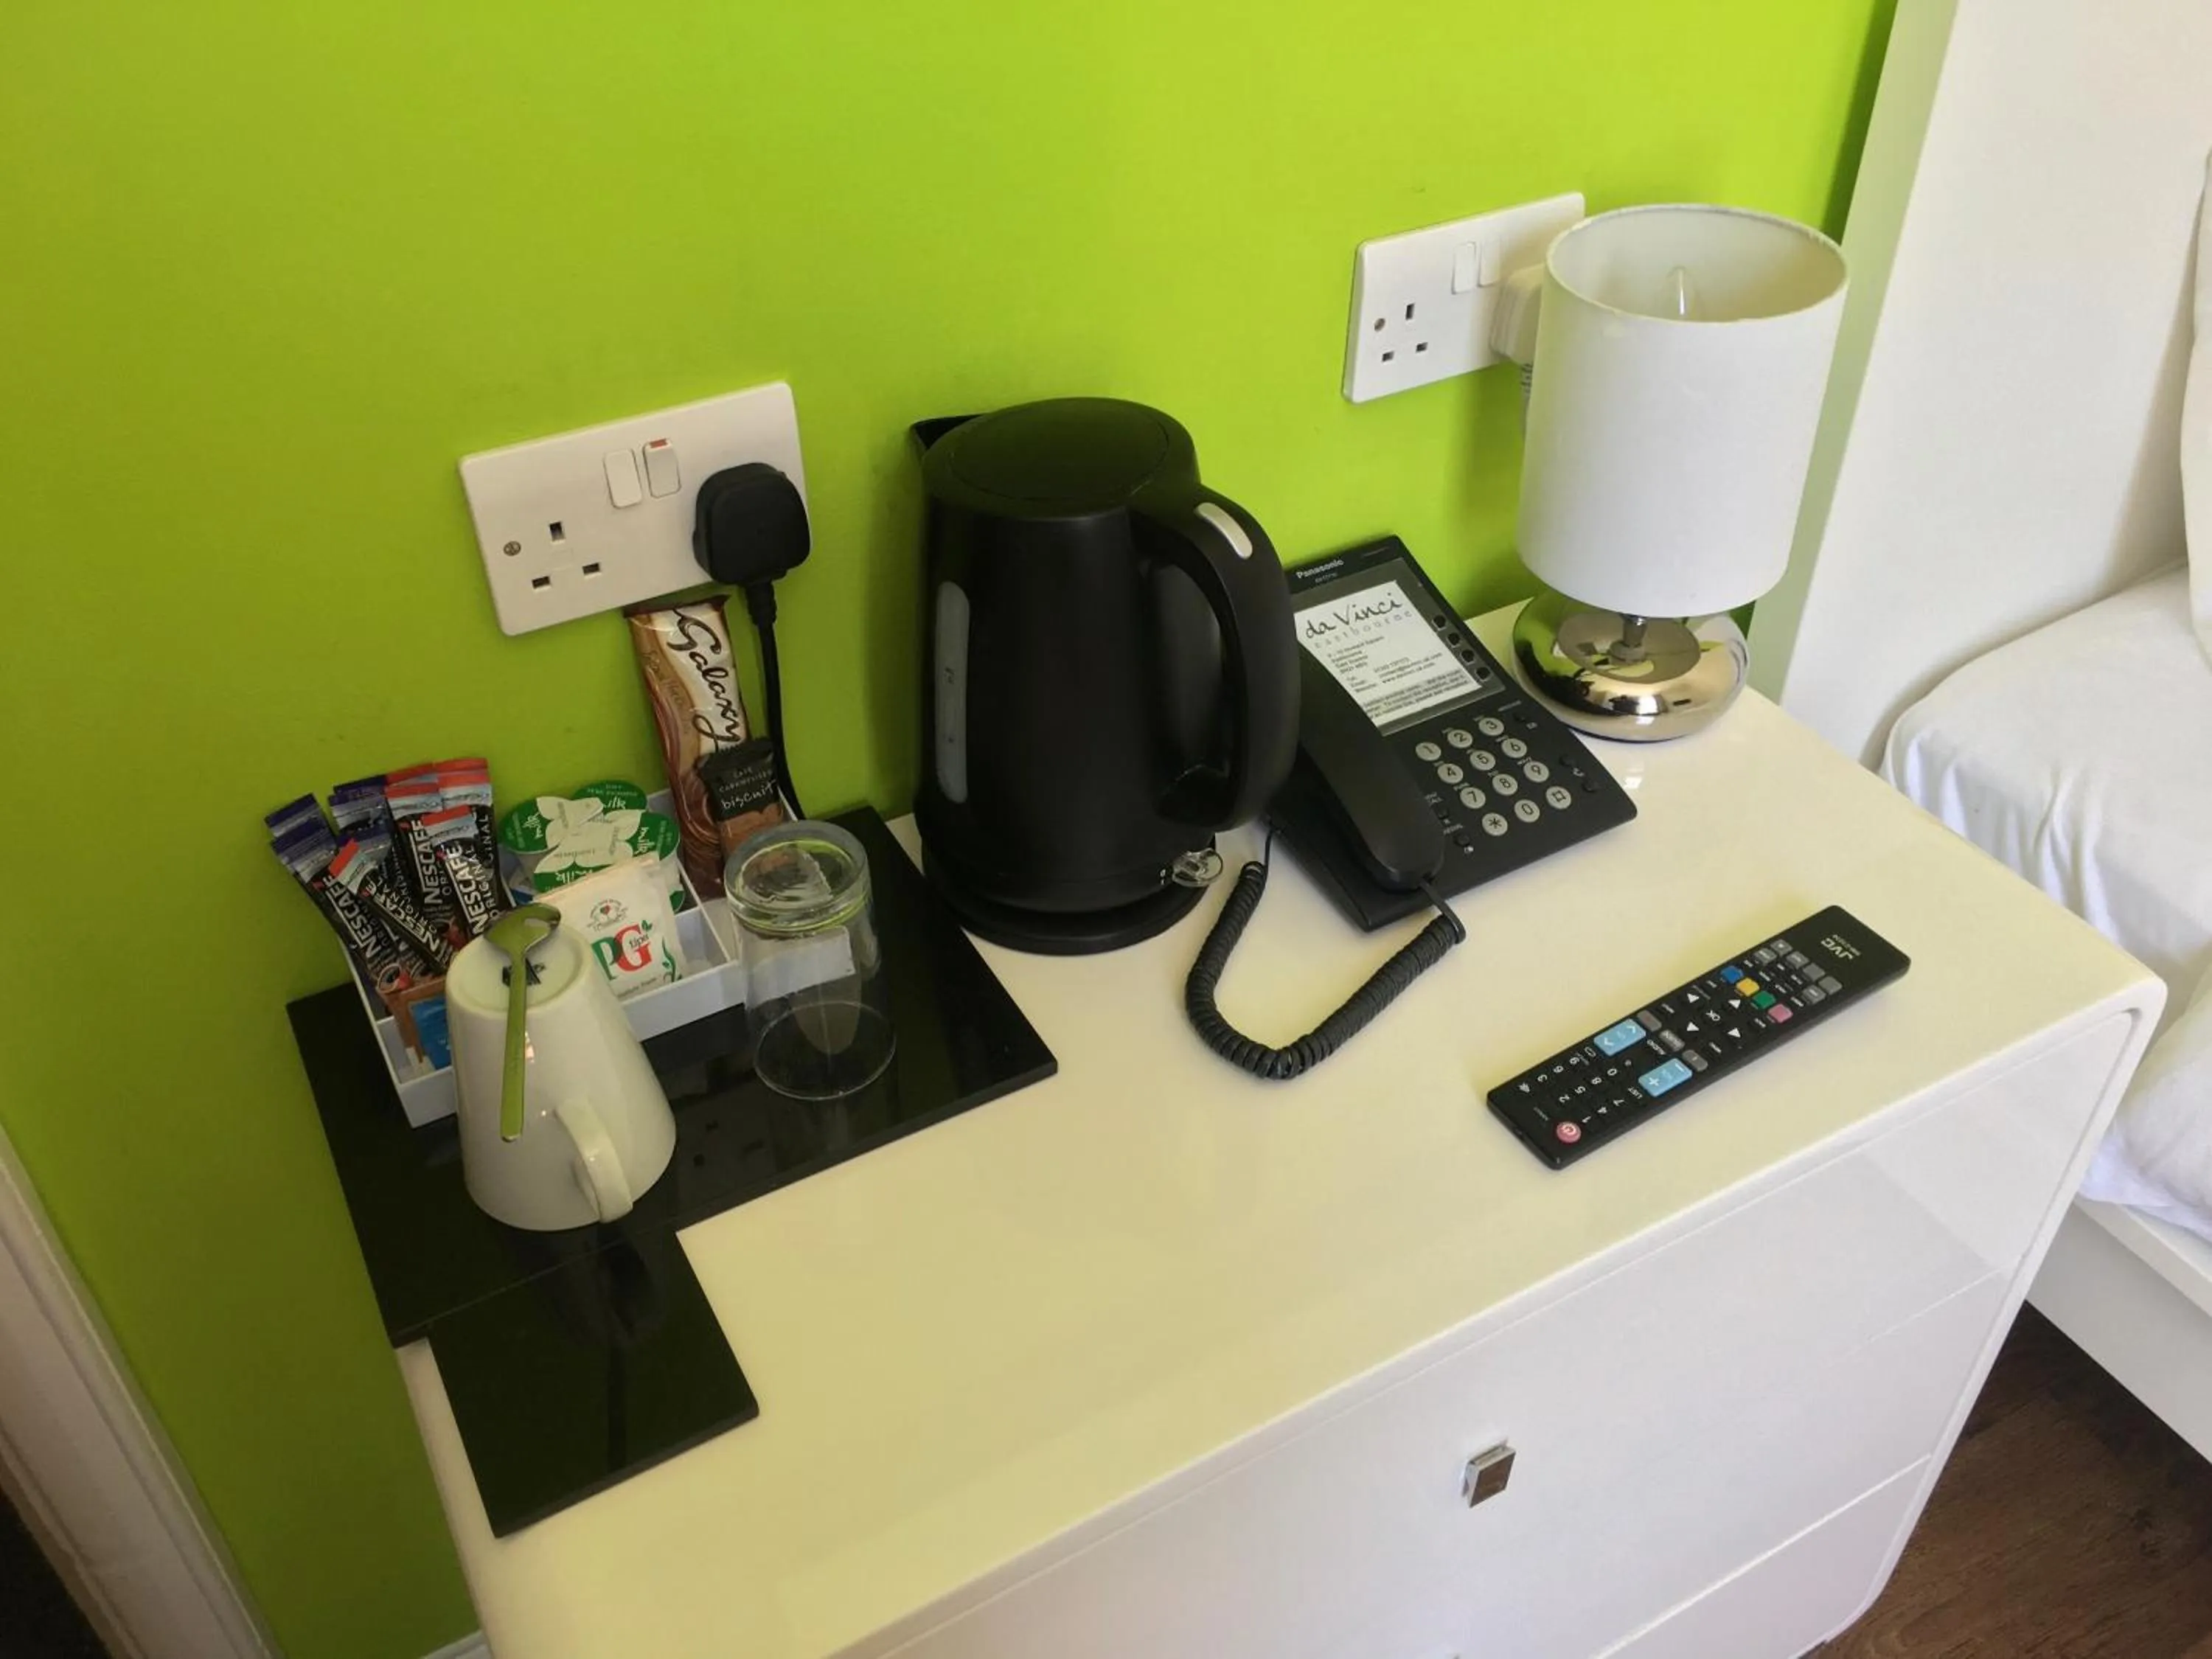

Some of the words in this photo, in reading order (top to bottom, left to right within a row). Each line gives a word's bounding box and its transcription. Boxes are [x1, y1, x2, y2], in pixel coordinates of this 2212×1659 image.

[1295, 558, 1344, 580] Panasonic
[1306, 619, 1337, 639] da
[1333, 592, 1402, 626] Vinci
[666, 608, 741, 752] Galaxy
[591, 923, 653, 981] PG
[1820, 937, 1854, 960] JVC
[1705, 1009, 1721, 1021] OK
